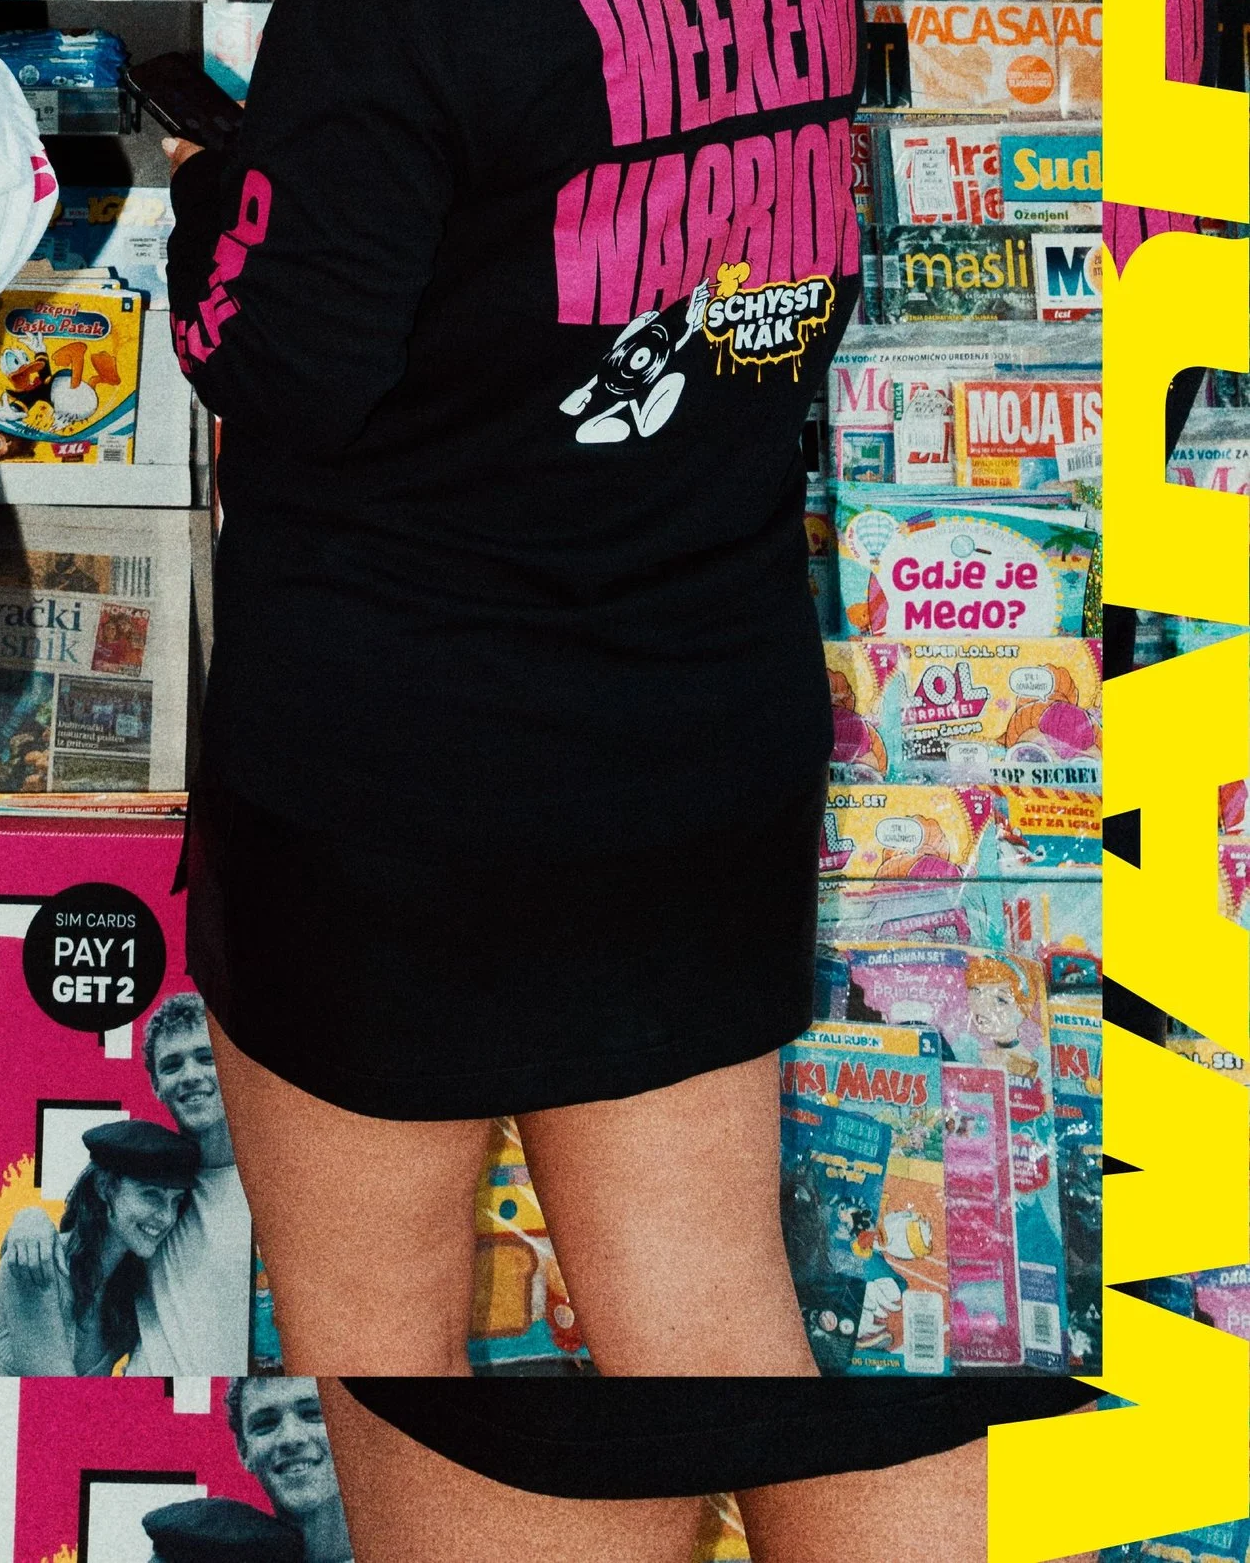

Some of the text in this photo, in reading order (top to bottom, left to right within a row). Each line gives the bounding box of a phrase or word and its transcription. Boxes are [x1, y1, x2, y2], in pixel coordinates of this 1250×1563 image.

[1014, 206, 1069, 222] Oženjeni
[905, 239, 1028, 289] masli
[707, 281, 826, 329] SCHYSST
[12, 316, 104, 337] Paško Patak
[833, 353, 851, 364] VAŠ
[852, 352, 878, 363] VODIČ
[880, 354, 890, 363] ZA
[892, 352, 947, 363] EKONOMIČNO
[967, 390, 1064, 445] MOJA
[58, 442, 85, 455] XXL
[892, 557, 1038, 592] Gdje je
[914, 645, 1019, 658] SUPER L.O.L. SET
[990, 767, 1100, 784] TOP SECRET
[974, 803, 983, 814] 2
[1019, 817, 1046, 828] SET
[1046, 819, 1066, 829] ZA
[55, 911, 137, 929] SIM CARDS
[54, 937, 135, 968] PAY 1
[52, 974, 135, 1005] GET 2
[835, 1061, 928, 1107] MAUS
